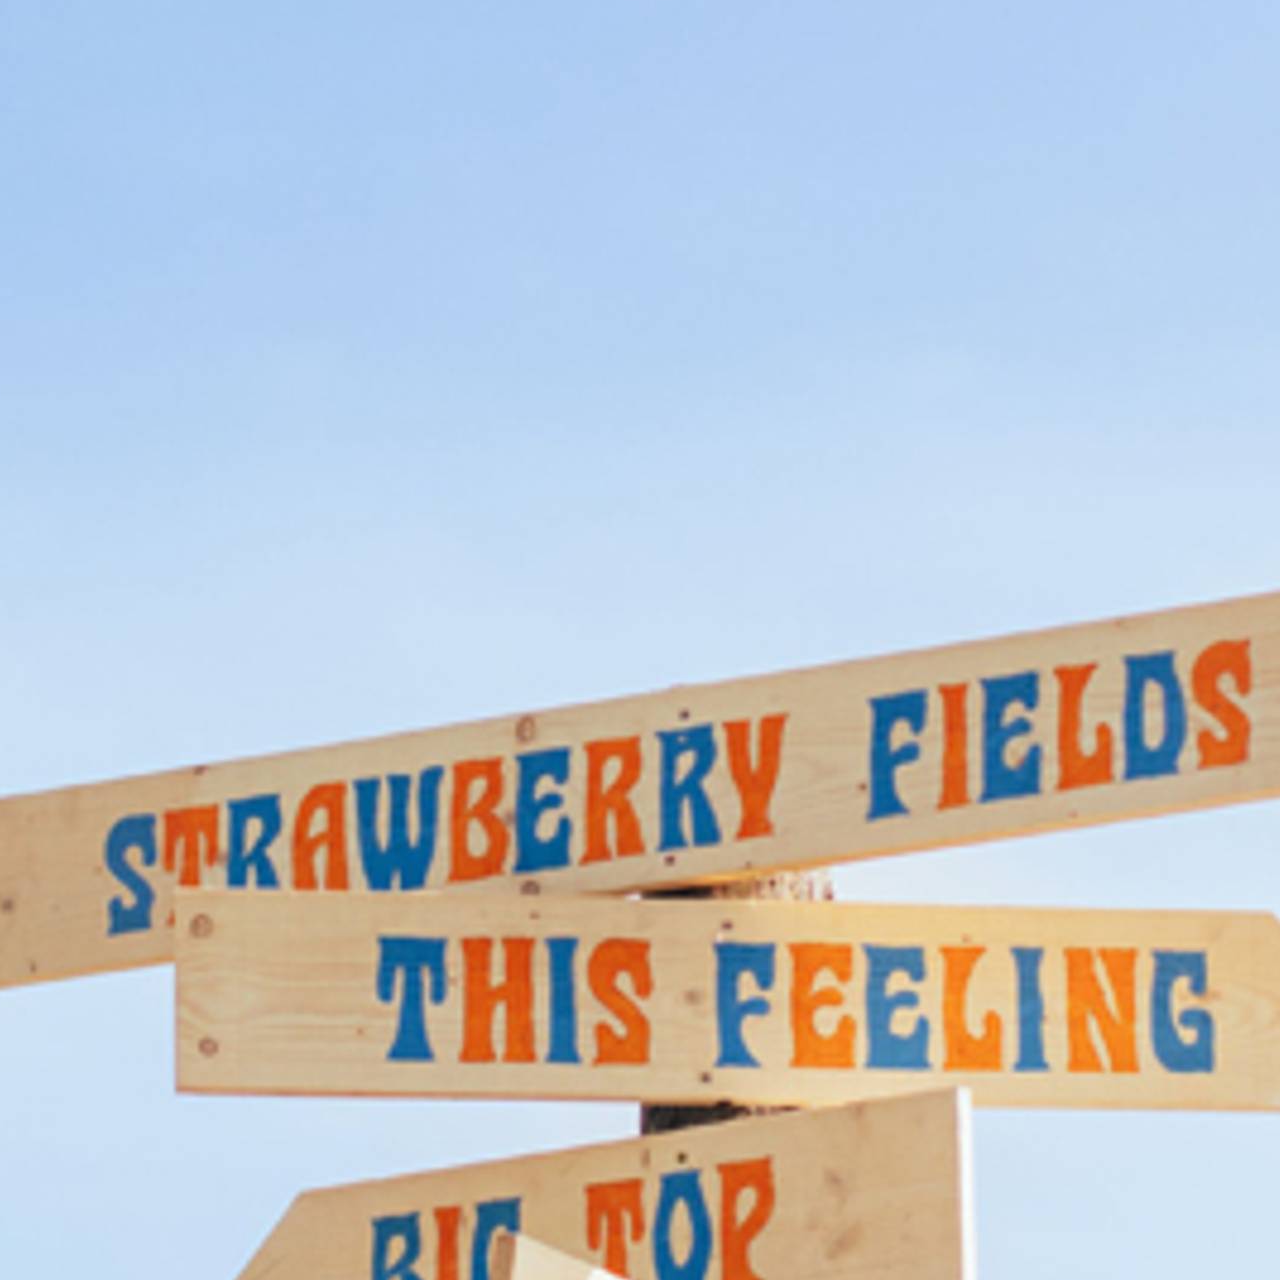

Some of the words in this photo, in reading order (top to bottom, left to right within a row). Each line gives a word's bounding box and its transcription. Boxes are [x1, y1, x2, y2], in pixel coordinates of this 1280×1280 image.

[104, 713, 790, 936] STRAWBERRY
[866, 639, 1253, 822] FIELDS
[376, 936, 653, 1066] THIS
[714, 941, 1216, 1074] FEELING
